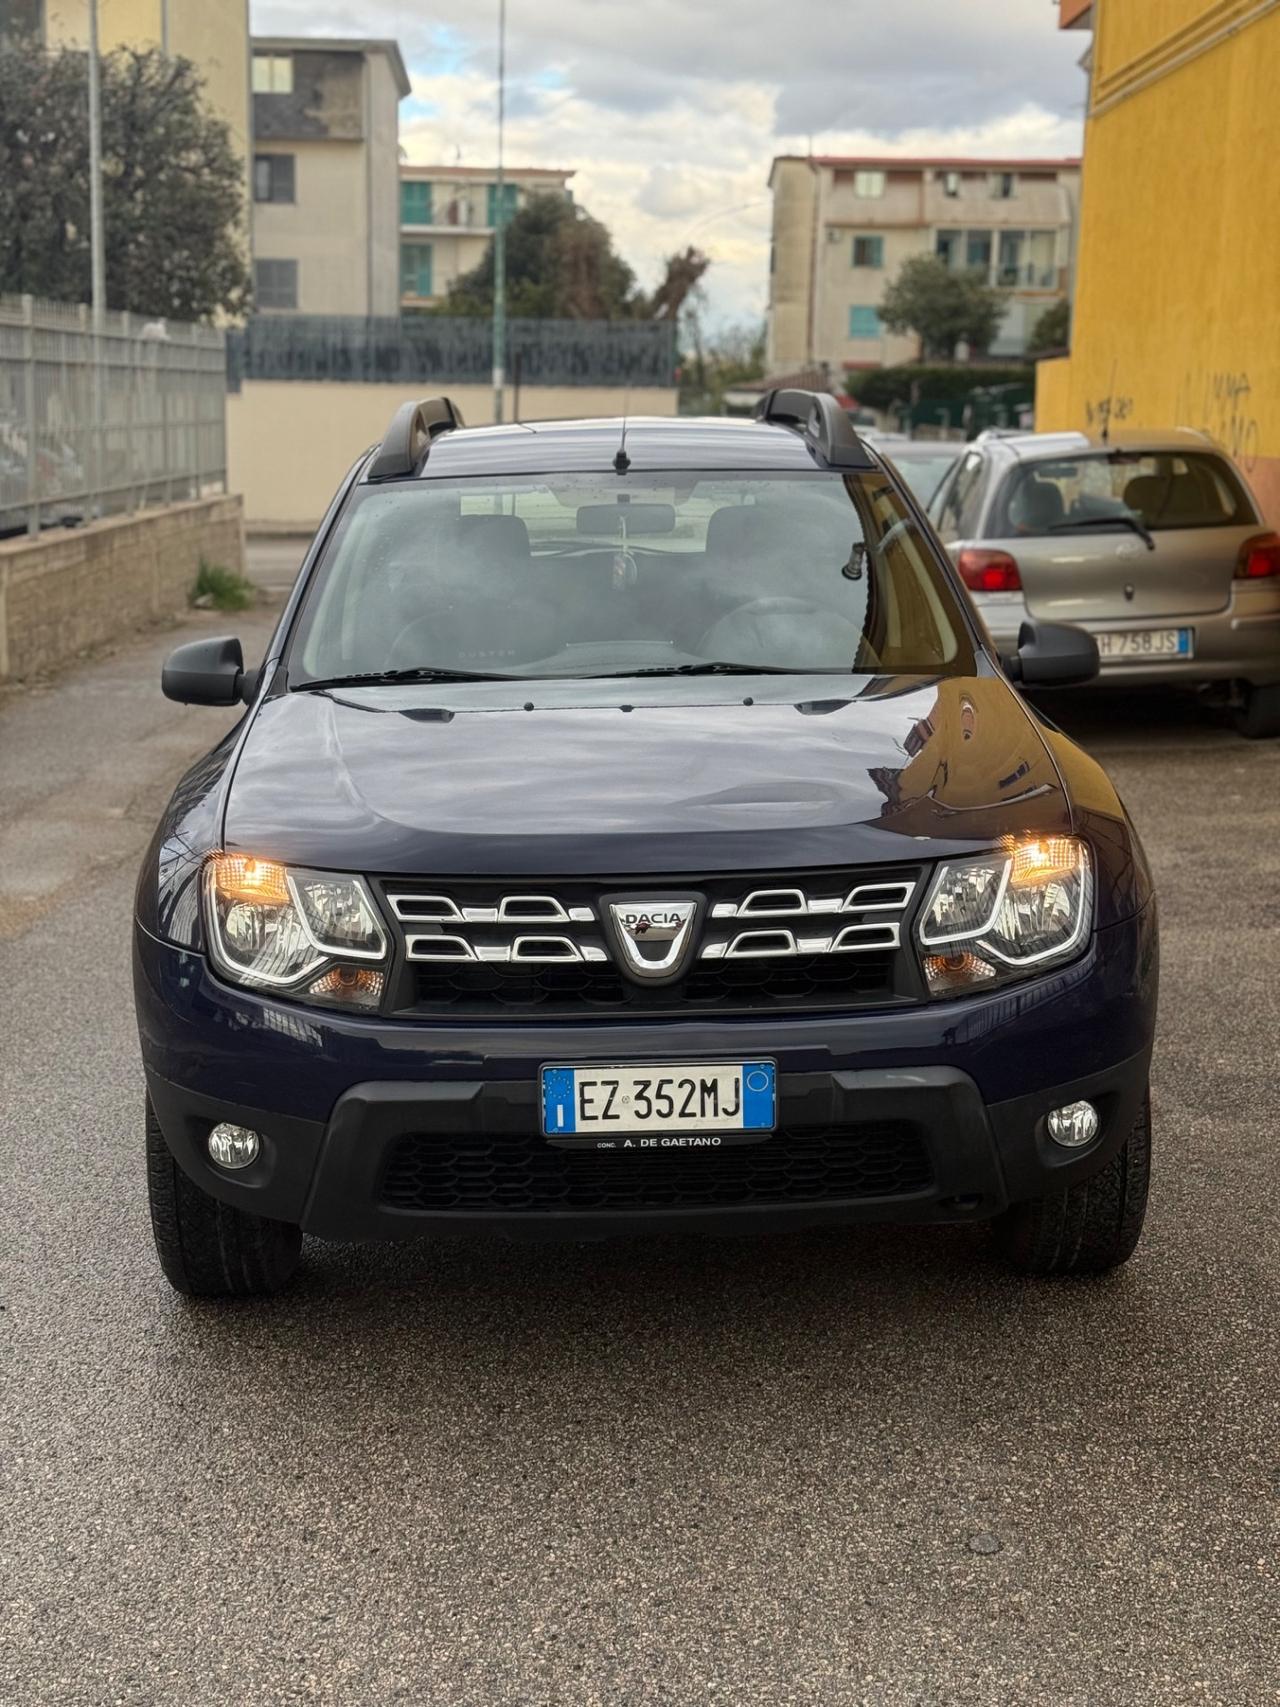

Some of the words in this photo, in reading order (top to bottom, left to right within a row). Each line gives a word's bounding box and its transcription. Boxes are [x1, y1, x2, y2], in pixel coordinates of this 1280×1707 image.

[1100, 632, 1112, 653] H
[1119, 630, 1176, 653] 758JS
[625, 912, 682, 924] DACIA
[579, 1079, 620, 1121] EZ
[632, 1077, 740, 1119] 352MJ
[623, 1139, 636, 1148] A.
[640, 1138, 658, 1147] DE
[660, 1137, 721, 1147] GAETANO
